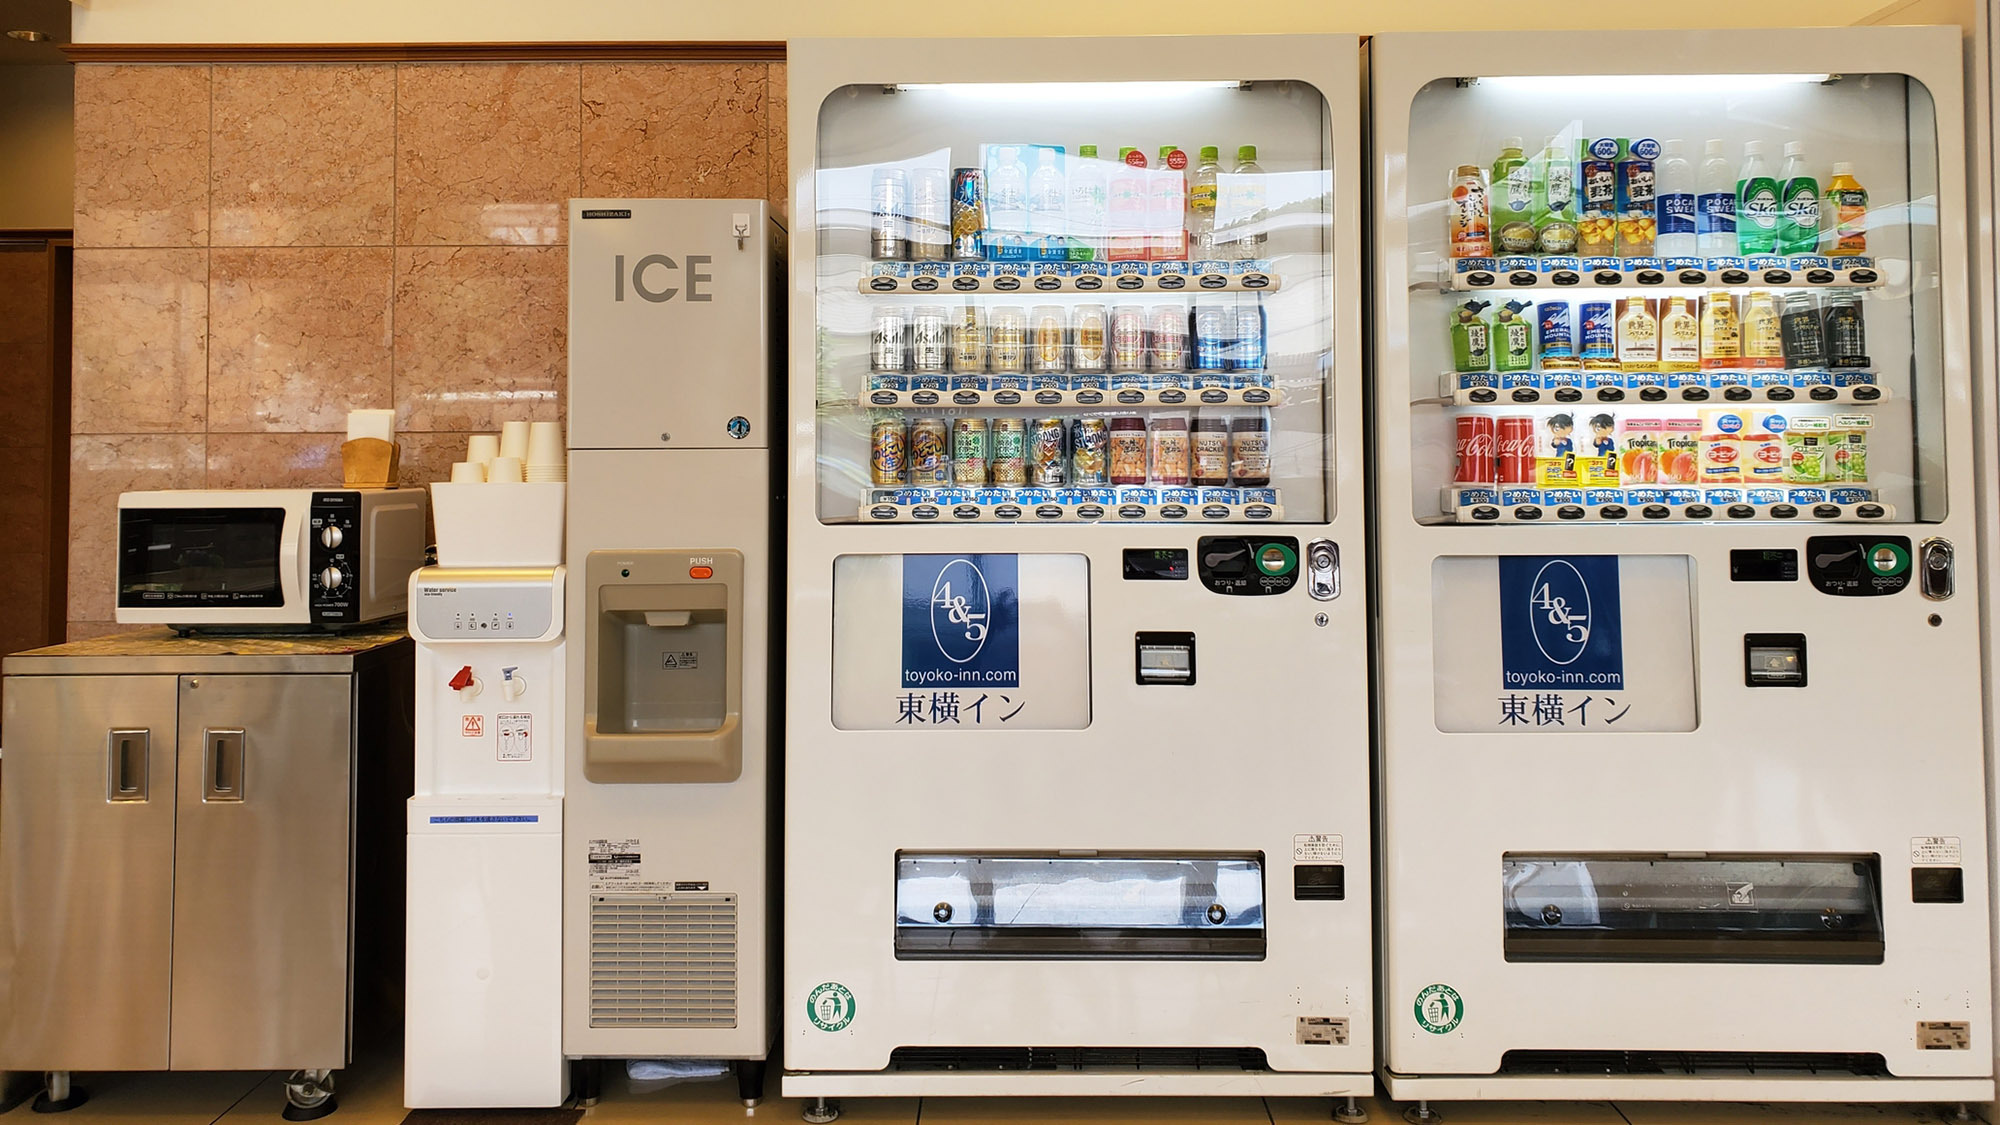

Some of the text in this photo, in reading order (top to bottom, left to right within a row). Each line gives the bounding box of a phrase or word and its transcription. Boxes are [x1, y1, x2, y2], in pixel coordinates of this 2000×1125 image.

[1588, 176, 1613, 185] おいしい
[1630, 176, 1654, 185] おいしい
[1590, 184, 1613, 198] 麦茶
[1633, 184, 1655, 198] 麦茶
[915, 262, 950, 270] つめたい
[955, 262, 990, 270] つめたい
[995, 262, 1030, 270] つめたい
[1035, 262, 1069, 270] つめたい
[1072, 262, 1107, 270] つめたい
[1112, 262, 1147, 270] つめたい
[1152, 262, 1187, 270] つめたい
[1459, 258, 1495, 266] つめたい
[1501, 258, 1536, 266] つめたい
[1542, 258, 1578, 266] つめたい
[1583, 258, 1619, 266] つめたい
[1625, 258, 1661, 266] つめたい
[1667, 258, 1703, 266] つめたい
[1708, 258, 1744, 266] つめたい
[1750, 258, 1786, 266] つめたい
[1792, 258, 1828, 266] つめたい
[1833, 258, 1870, 266] つめたい
[615, 254, 712, 303] ICE
[925, 346, 934, 354] 生
[1462, 490, 1497, 498] つめたい
[1504, 490, 1539, 498] つめたい
[1545, 490, 1581, 498] つめたい
[1586, 490, 1622, 498] つめたい
[1628, 490, 1664, 498] つめたい
[1665, 490, 1700, 498] つめたい
[1707, 490, 1742, 498] つめたい
[1748, 490, 1783, 498] つめたい
[1789, 490, 1825, 498] つめたい
[1831, 490, 1867, 498] つめたい
[690, 557, 713, 566] PUSH
[1214, 579, 1246, 587] おつり・返却
[1826, 580, 1859, 588] おつり・返却
[905, 668, 1016, 684] toyoko-inn.com
[1506, 670, 1621, 687] toyoko-inn.com
[895, 692, 1026, 725] 東横イン
[1498, 693, 1631, 727] 東横イン
[809, 983, 852, 1004] のんだあとは
[1416, 985, 1459, 1006] のんだあとは
[813, 1016, 851, 1031] リサイクル
[1421, 1018, 1459, 1033] リサイクル
